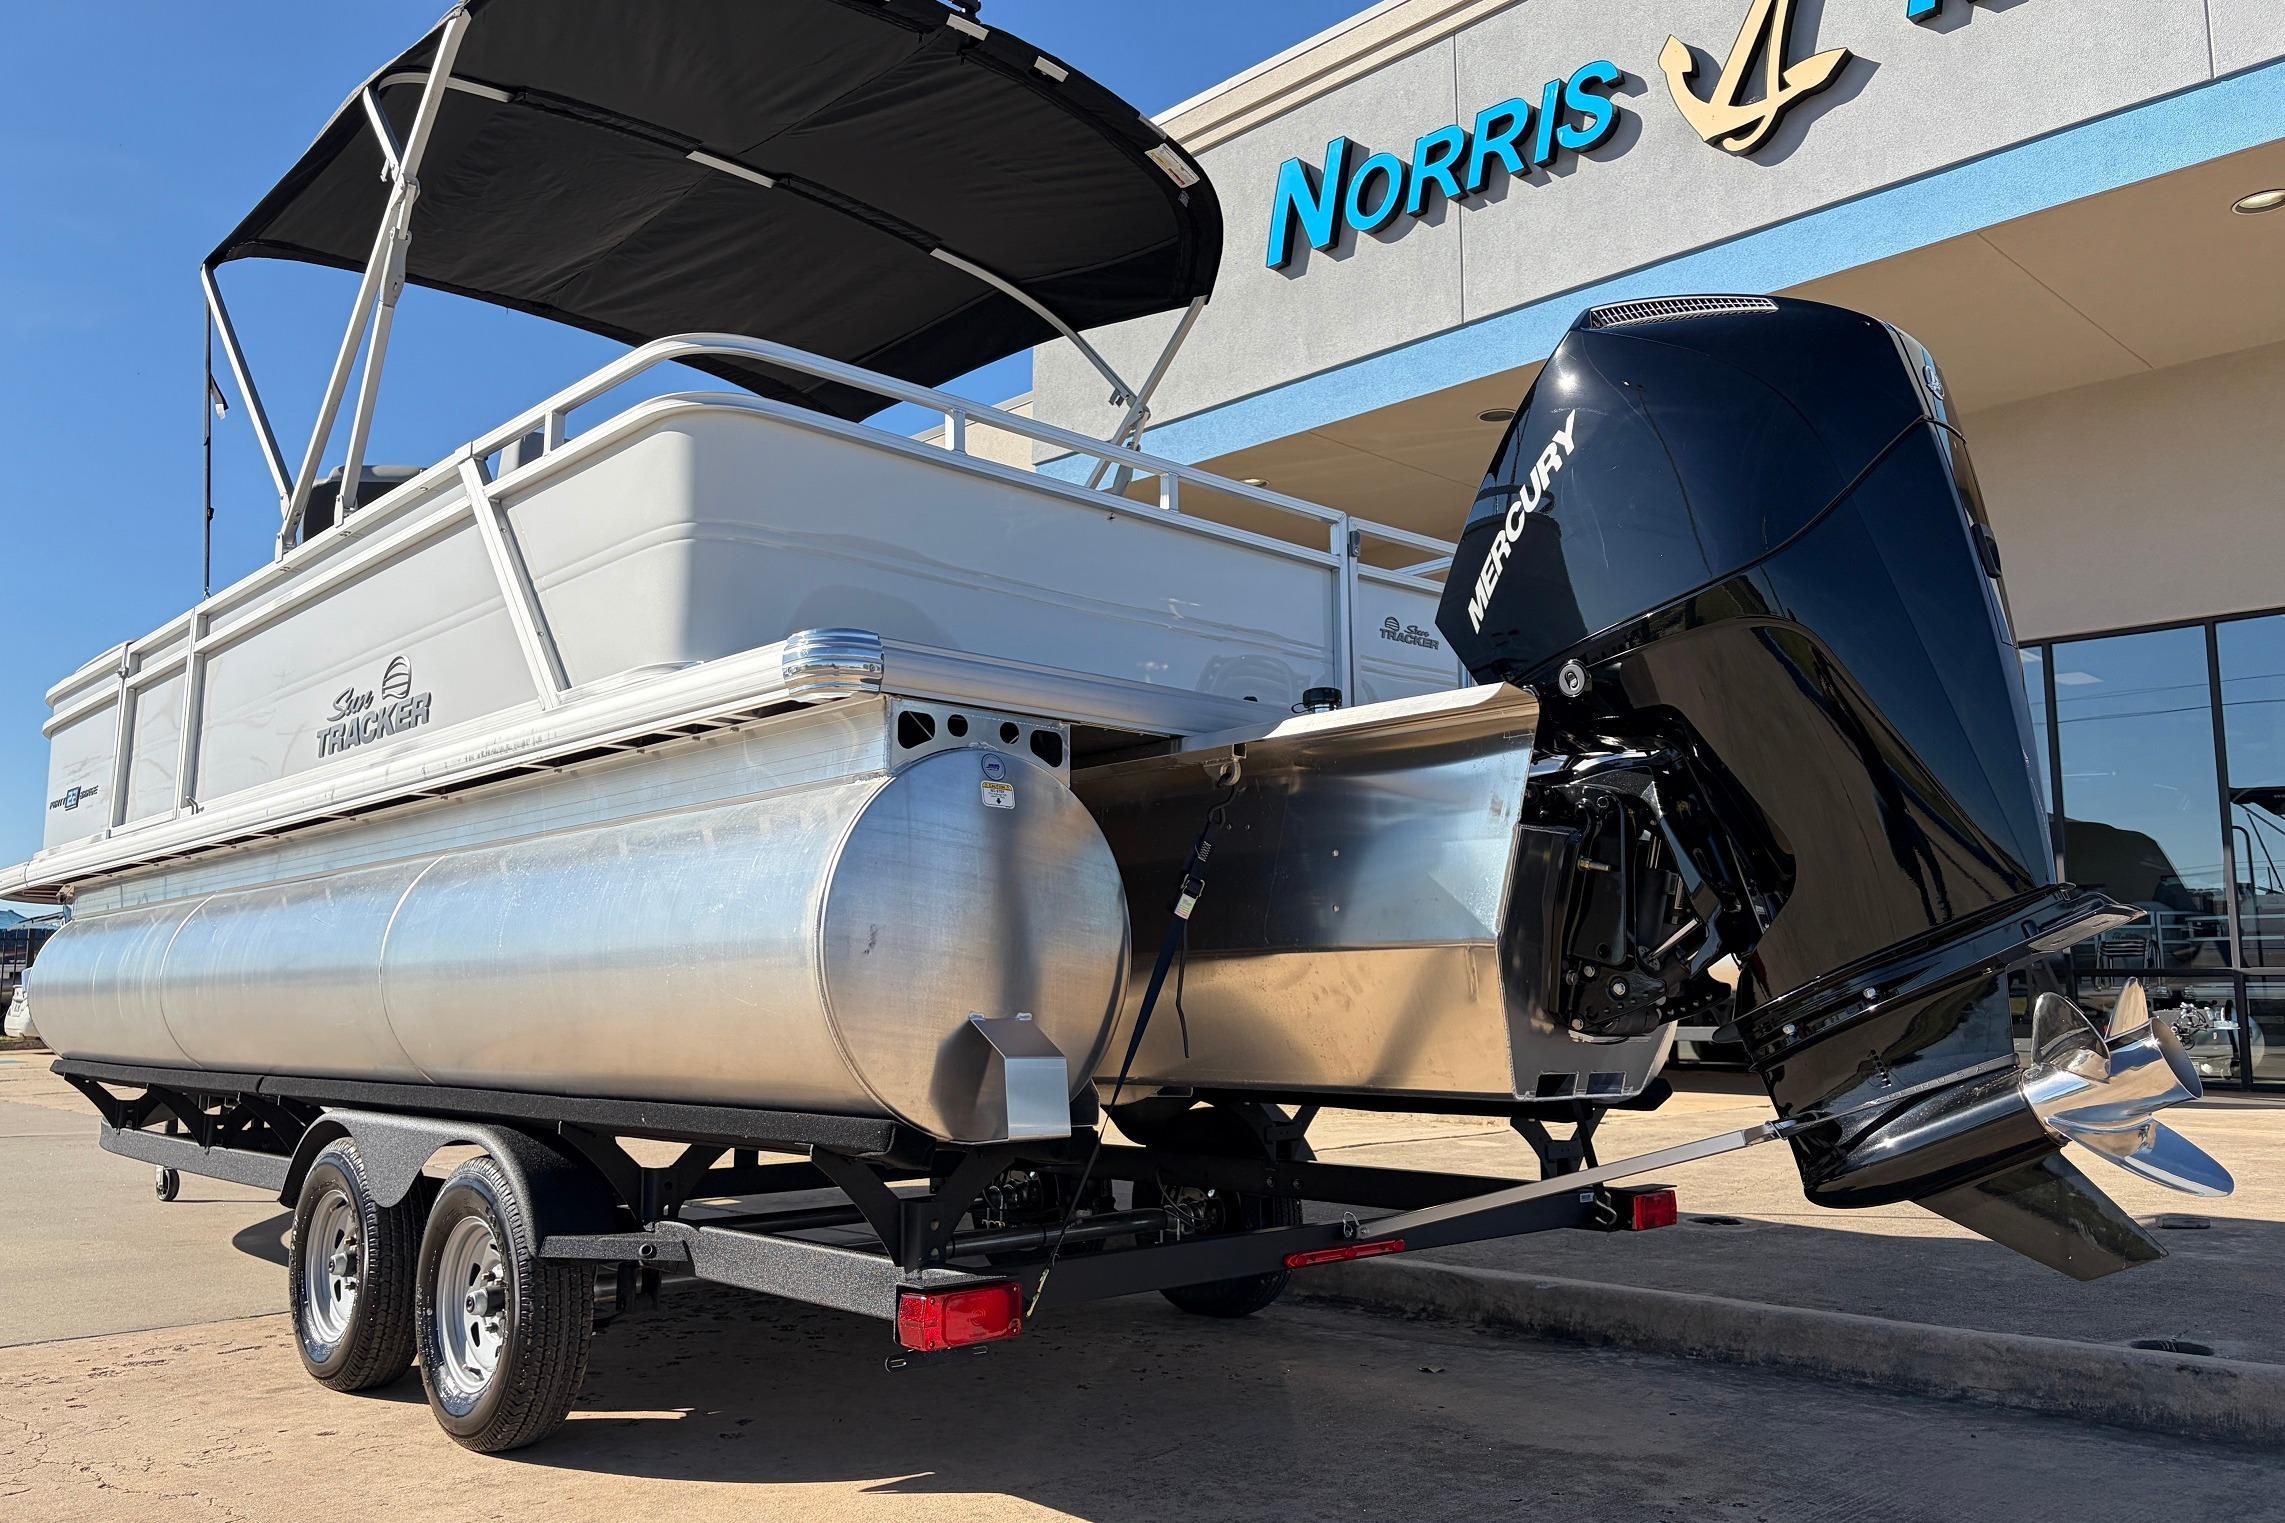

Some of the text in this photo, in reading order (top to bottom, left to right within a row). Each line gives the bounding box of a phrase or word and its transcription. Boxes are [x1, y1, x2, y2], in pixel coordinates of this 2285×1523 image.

[1266, 59, 1625, 270] NORRIS
[1467, 409, 1575, 635] MERCURY
[1379, 627, 1440, 650] TRACKER
[316, 691, 432, 759] TRACKER
[326, 686, 375, 722] Sun
